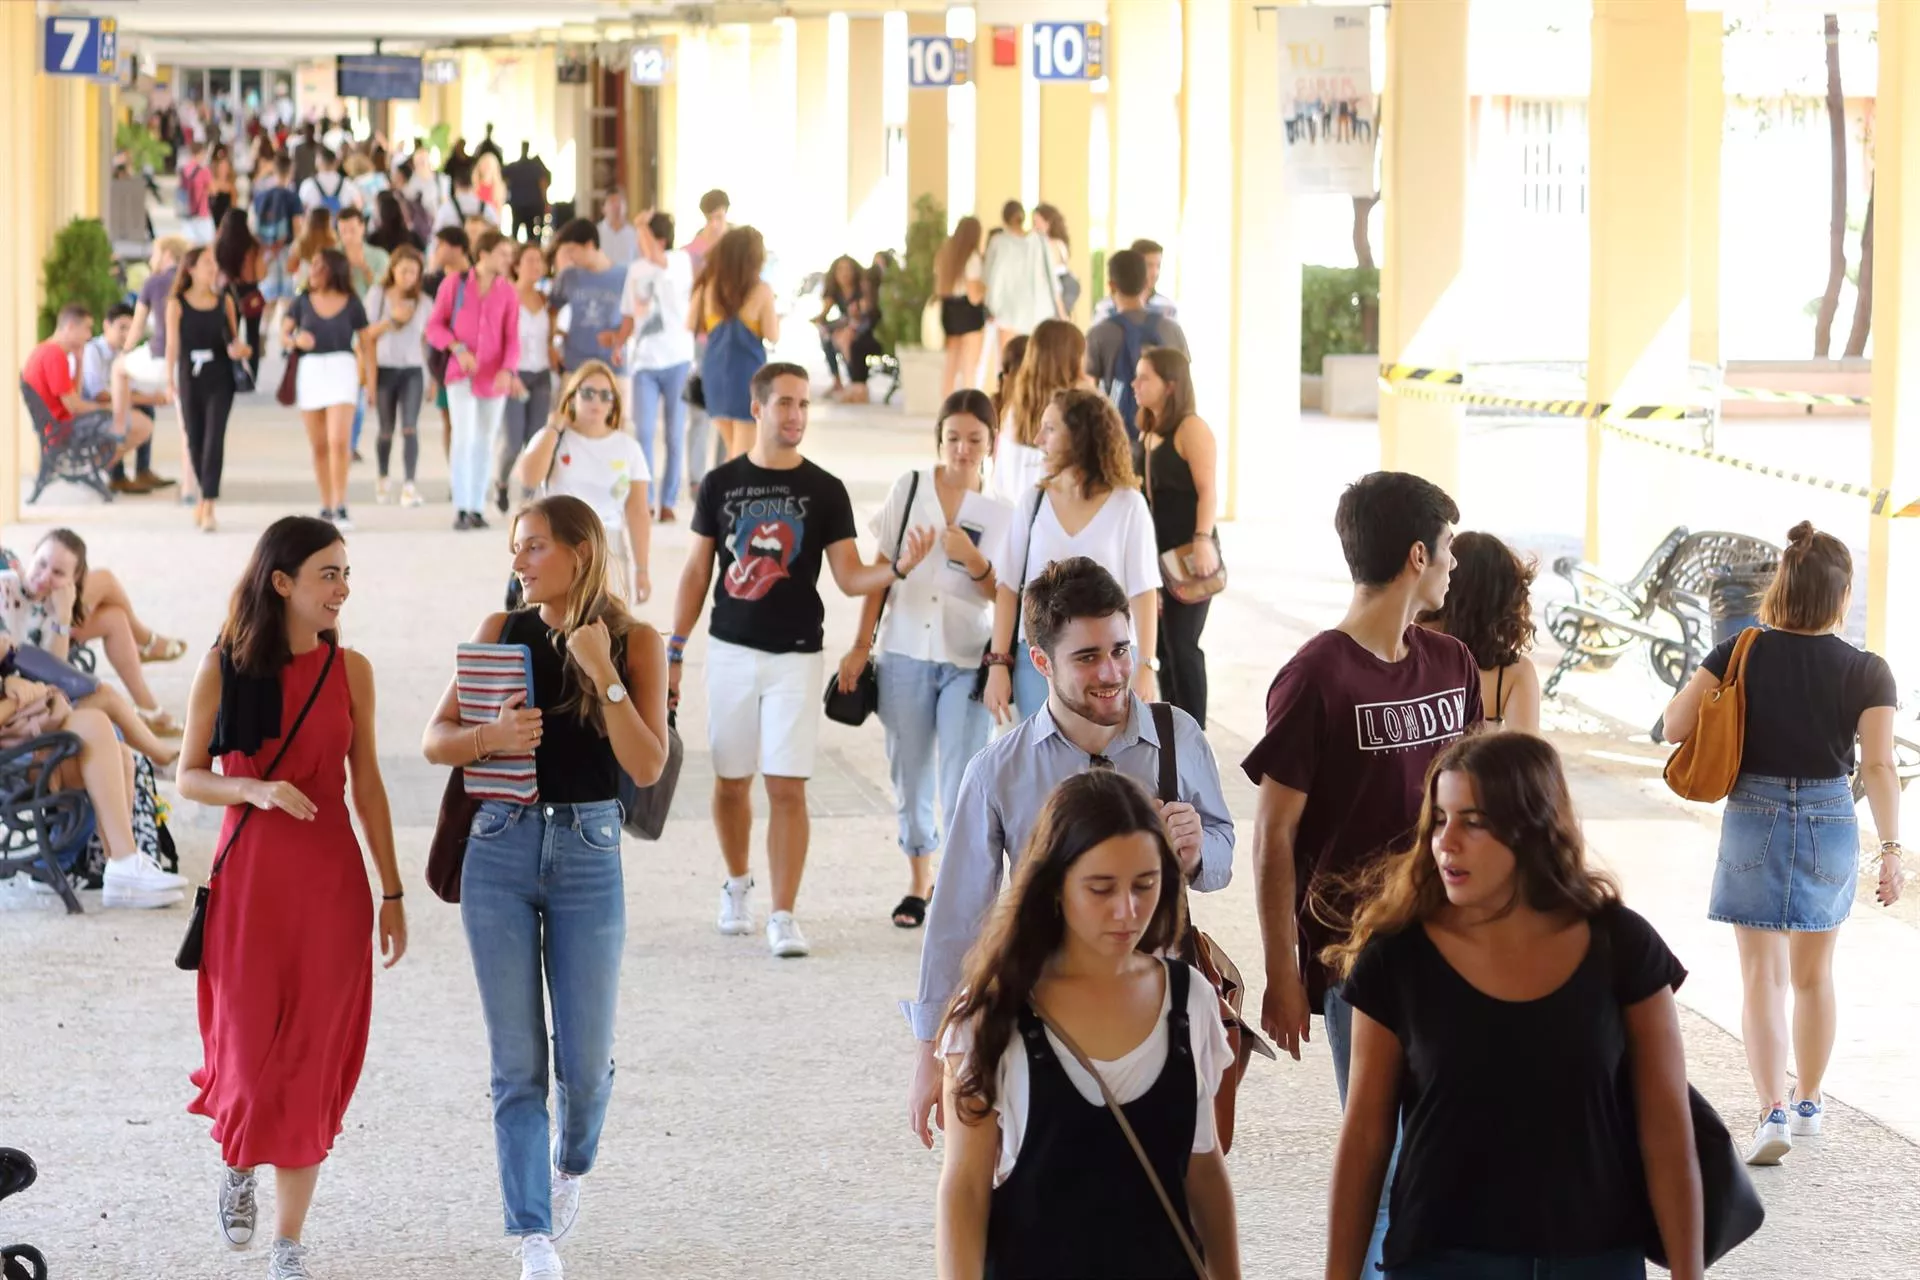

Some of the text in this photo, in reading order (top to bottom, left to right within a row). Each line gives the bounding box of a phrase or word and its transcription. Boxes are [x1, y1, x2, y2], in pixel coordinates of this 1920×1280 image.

[54, 20, 90, 70] 7
[909, 40, 951, 83] 10
[1034, 25, 1083, 76] 10
[633, 48, 661, 80] 12
[747, 485, 790, 497] ROLLING
[724, 497, 810, 528] STONES
